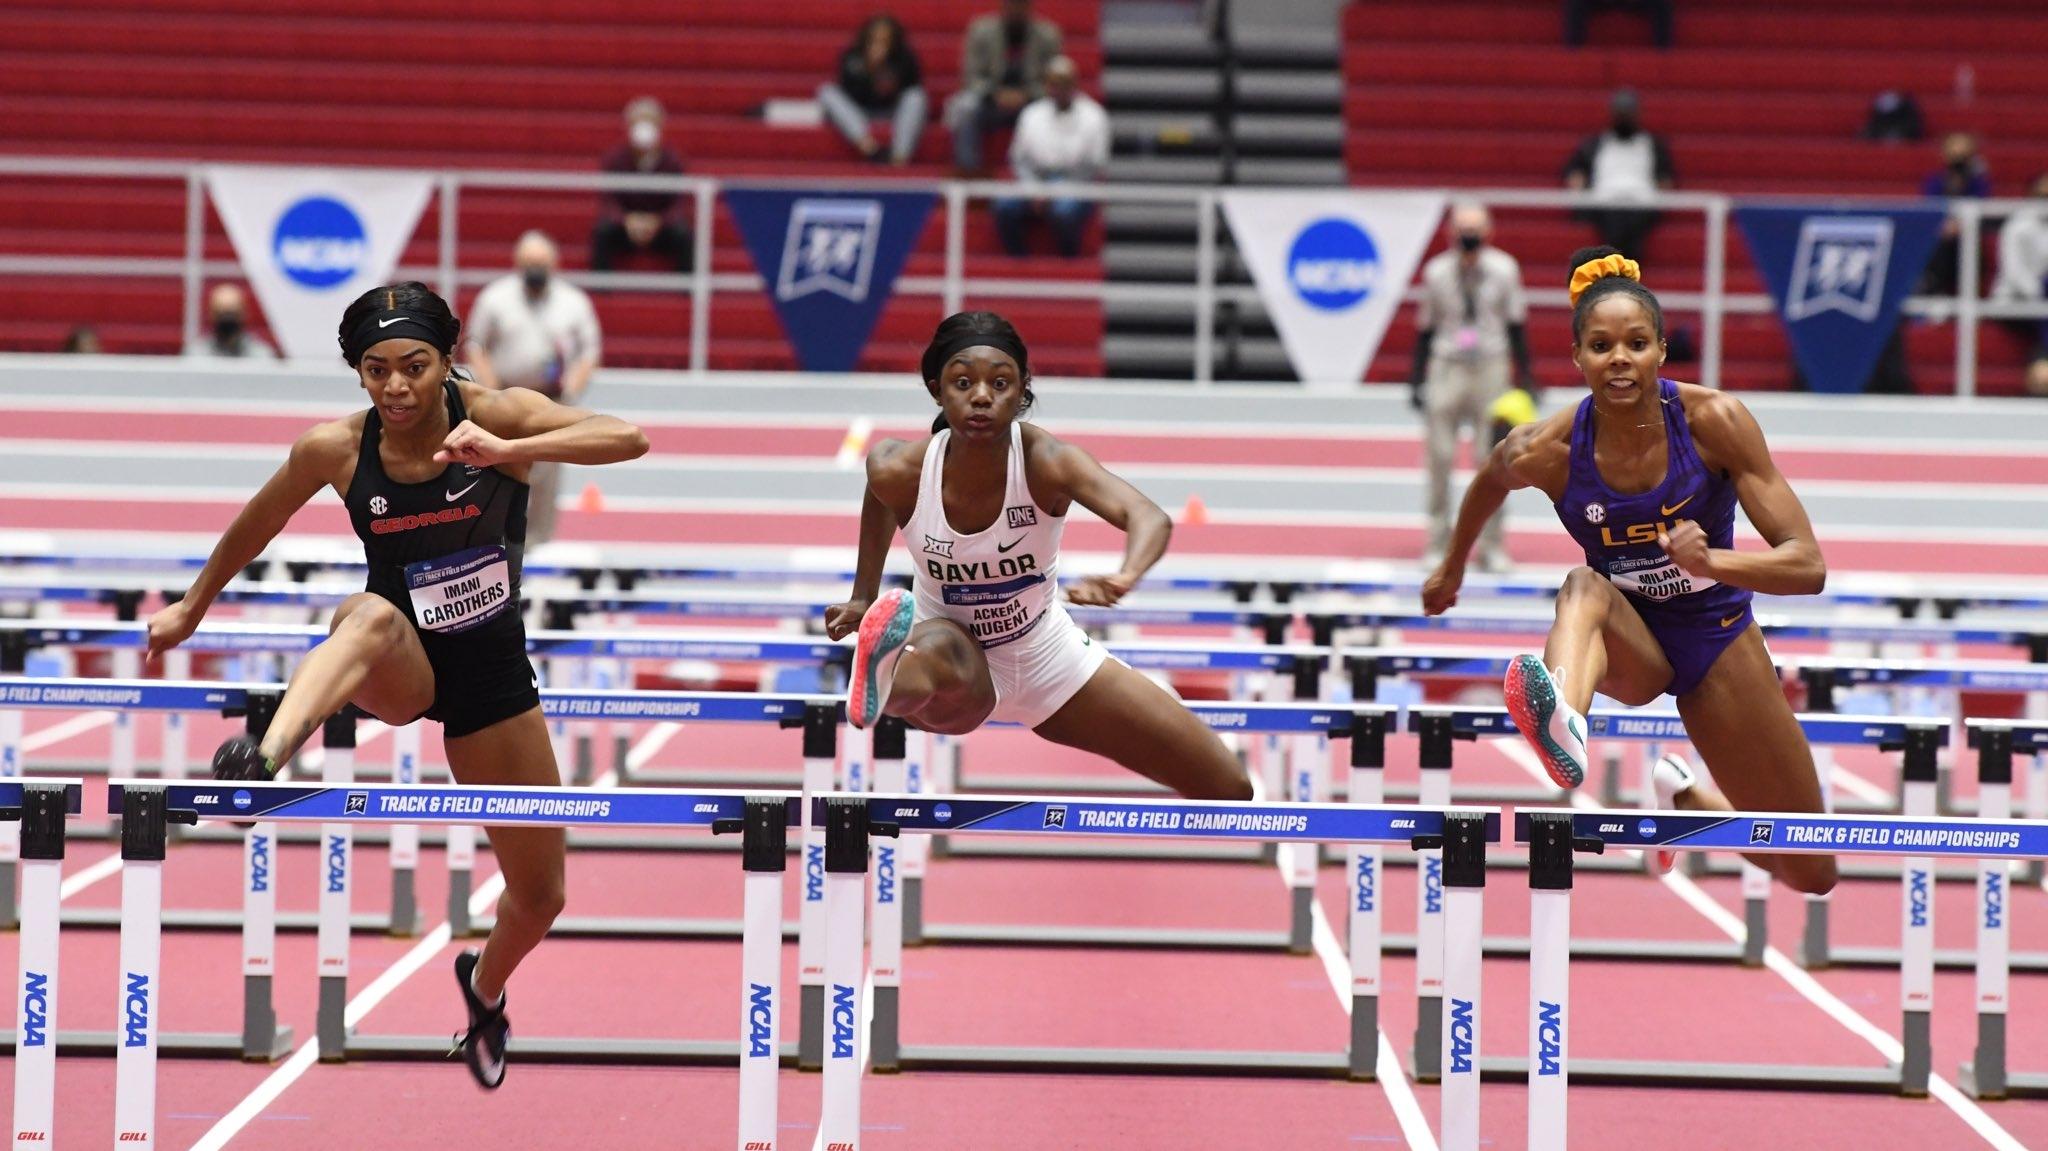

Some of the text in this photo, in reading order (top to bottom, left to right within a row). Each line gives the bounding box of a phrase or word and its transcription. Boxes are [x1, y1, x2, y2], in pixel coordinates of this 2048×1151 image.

[369, 496, 388, 515] SEC
[1008, 507, 1033, 523] ONE
[1585, 502, 1605, 523] SEC
[371, 504, 482, 534] GEORGIA
[927, 553, 1037, 582] BAYLOR
[1638, 567, 1681, 584] MILAN
[443, 576, 481, 599] IMANI
[1638, 578, 1692, 597] YOUNG
[423, 582, 504, 625] CAROTHERS
[973, 599, 1021, 620] ACKERA
[969, 606, 1029, 637] NUGENT
[8, 687, 40, 702] FIELD
[43, 687, 141, 704] CHAMPIONSHIPS
[569, 699, 602, 714] FIELD
[603, 700, 700, 716] CHAMPIONSHIPS
[1617, 719, 1654, 735] TRACK
[193, 795, 219, 804] GILL
[380, 796, 610, 817] TRACK & FIELD CHAMPIONSHIPS
[693, 803, 720, 813] GILL
[894, 808, 920, 817] GILL
[1078, 810, 1308, 832] TRACK & FIELD CHAMPIONSHIPS
[1390, 819, 1416, 829] GILL
[1598, 823, 1625, 833] GILL
[1786, 826, 2020, 848] TRACK & FIELD CHAMPIONSHIPS
[251, 834, 268, 892] NCAA
[328, 835, 346, 893] NCAA
[806, 844, 824, 901] NCAA
[877, 846, 895, 903] NCAA
[1357, 855, 1374, 912] NCAA
[1425, 857, 1442, 914] NCAA
[1910, 869, 1927, 927] NCAA
[1984, 871, 2002, 929] NCAA
[24, 971, 47, 1047] NCAA
[125, 972, 149, 1047] NCAA
[749, 983, 772, 1058] NCAA
[832, 983, 855, 1058] NCAA
[1450, 998, 1473, 1074] NCAA
[1538, 1000, 1561, 1076] NCAA
[17, 1131, 46, 1141] GILL
[119, 1132, 148, 1142] GILL
[745, 1142, 772, 1151] GILL
[827, 1143, 854, 1151] GILL
